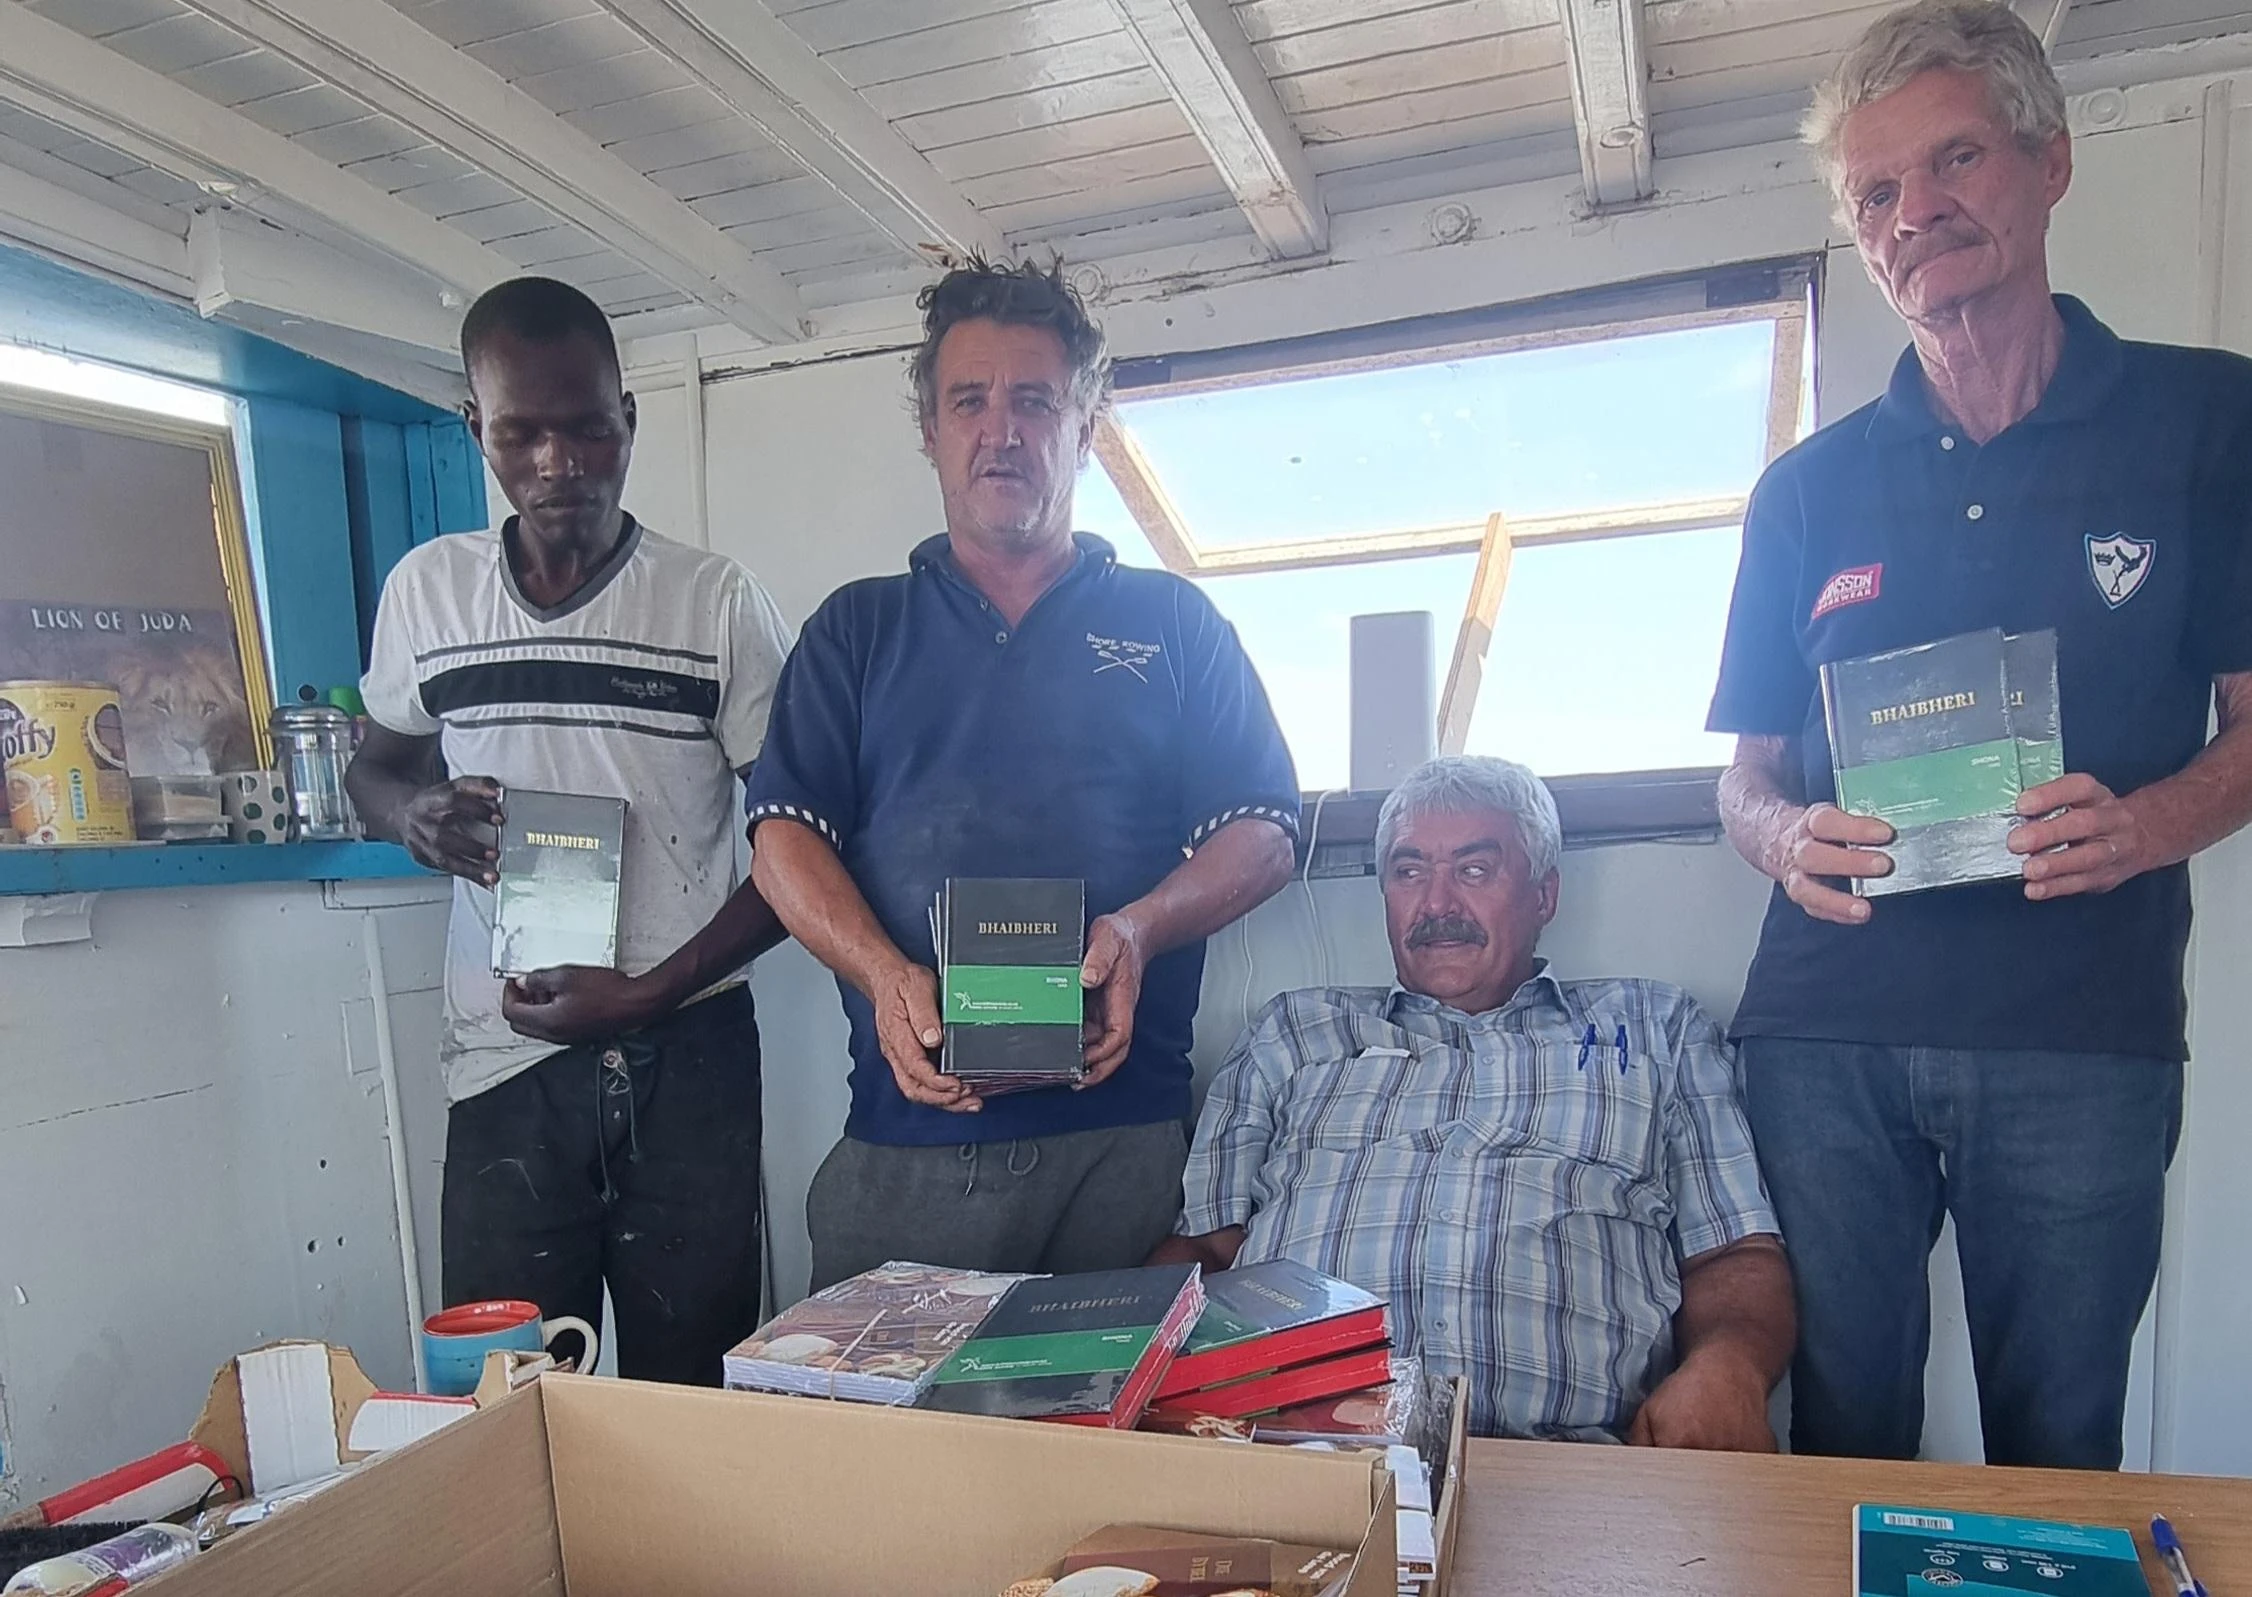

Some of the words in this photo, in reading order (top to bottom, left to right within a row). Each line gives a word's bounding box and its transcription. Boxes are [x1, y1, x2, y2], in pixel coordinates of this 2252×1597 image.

[31, 608, 83, 629] LION
[94, 610, 122, 630] OF
[140, 612, 193, 633] JUDA
[1870, 691, 1976, 725] BHAIBHERI
[0, 718, 55, 759] offy
[526, 832, 599, 849] BHAIBHERI
[978, 922, 1057, 935] BHAIBHERI
